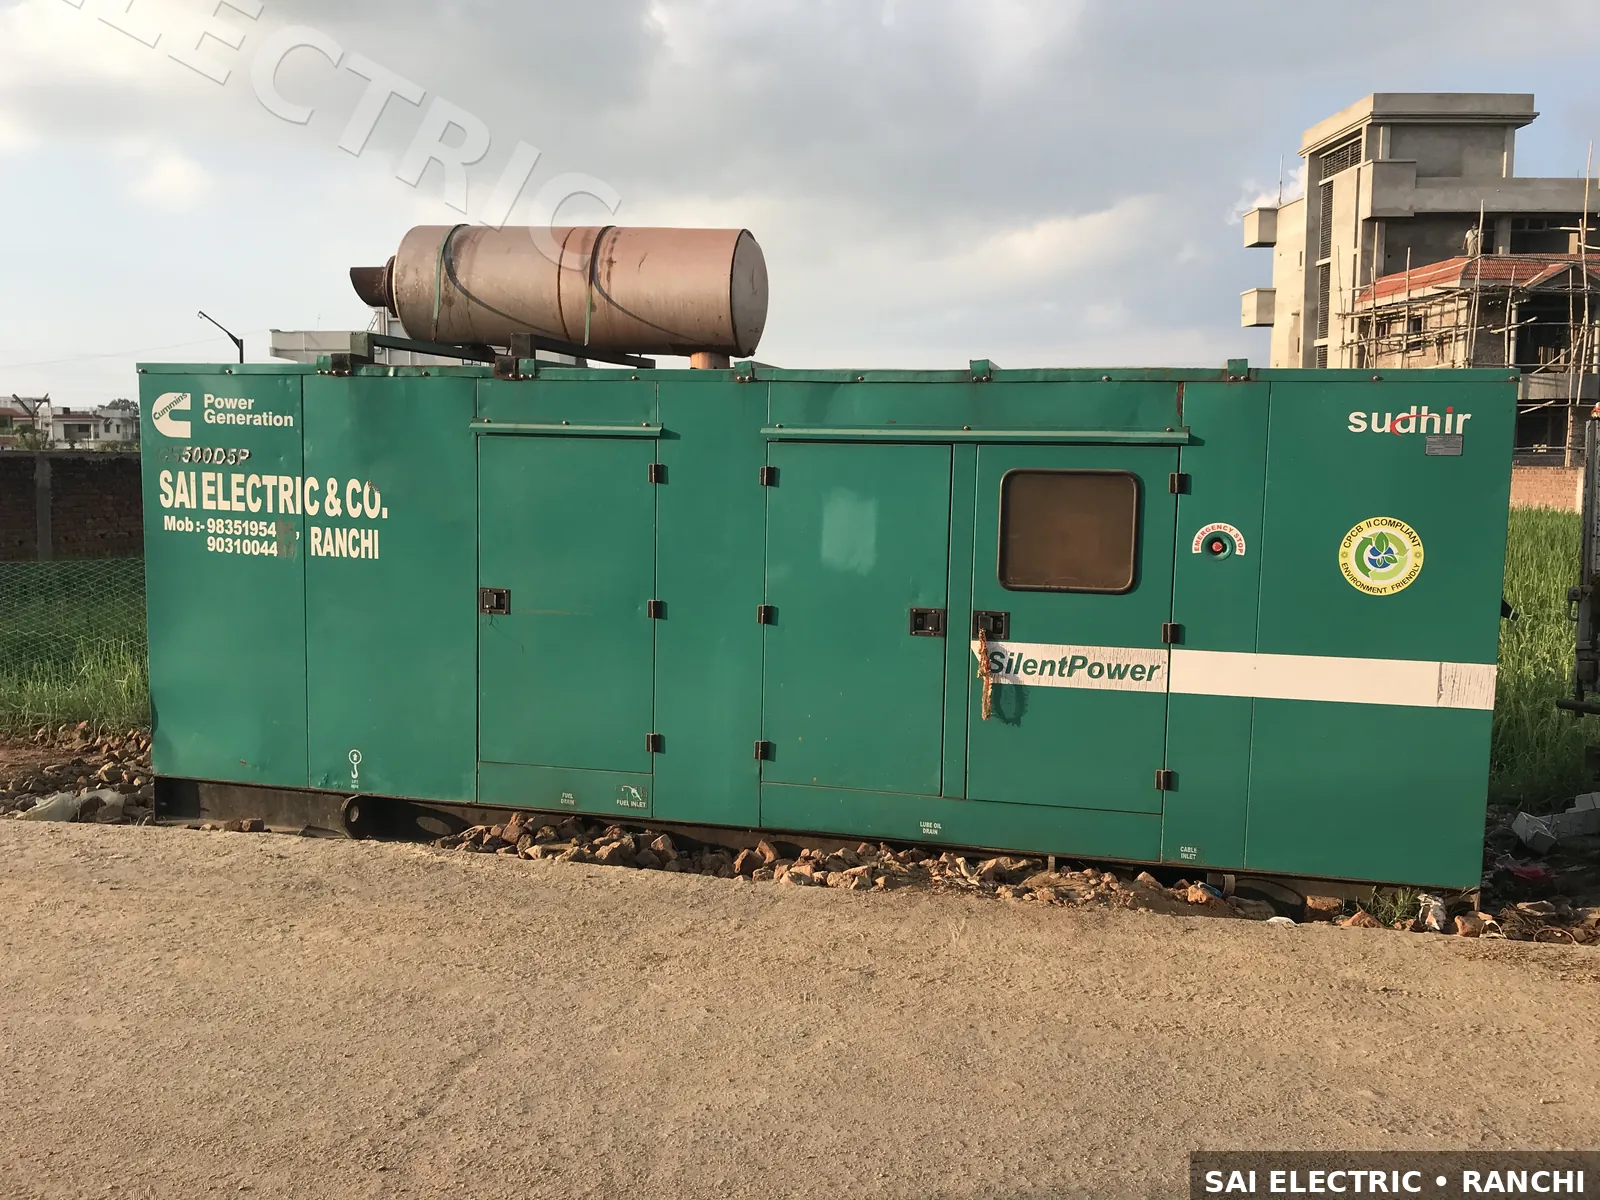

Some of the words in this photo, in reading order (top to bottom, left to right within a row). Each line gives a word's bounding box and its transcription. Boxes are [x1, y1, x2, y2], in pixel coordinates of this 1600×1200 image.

[152, 393, 188, 421] Cummins
[203, 393, 255, 410] Power
[203, 408, 294, 427] Generation
[1347, 405, 1472, 436] sudhir
[159, 470, 197, 509] SAI
[201, 471, 320, 516] ELECTRIC
[324, 477, 343, 517] &
[345, 478, 388, 519] CO.
[206, 536, 296, 558] 90310044
[310, 526, 379, 559] RANCHI
[1194, 524, 1234, 552] EMERGENCY
[1233, 532, 1244, 554] STOP
[1343, 525, 1364, 549] CPCB
[1373, 518, 1421, 548] COMPLIANT
[1341, 562, 1388, 594] ENVIRONMENT
[1391, 563, 1420, 592] FRIENDLY
[988, 650, 1161, 682] SilentPower
[1181, 846, 1197, 854] CABLE
